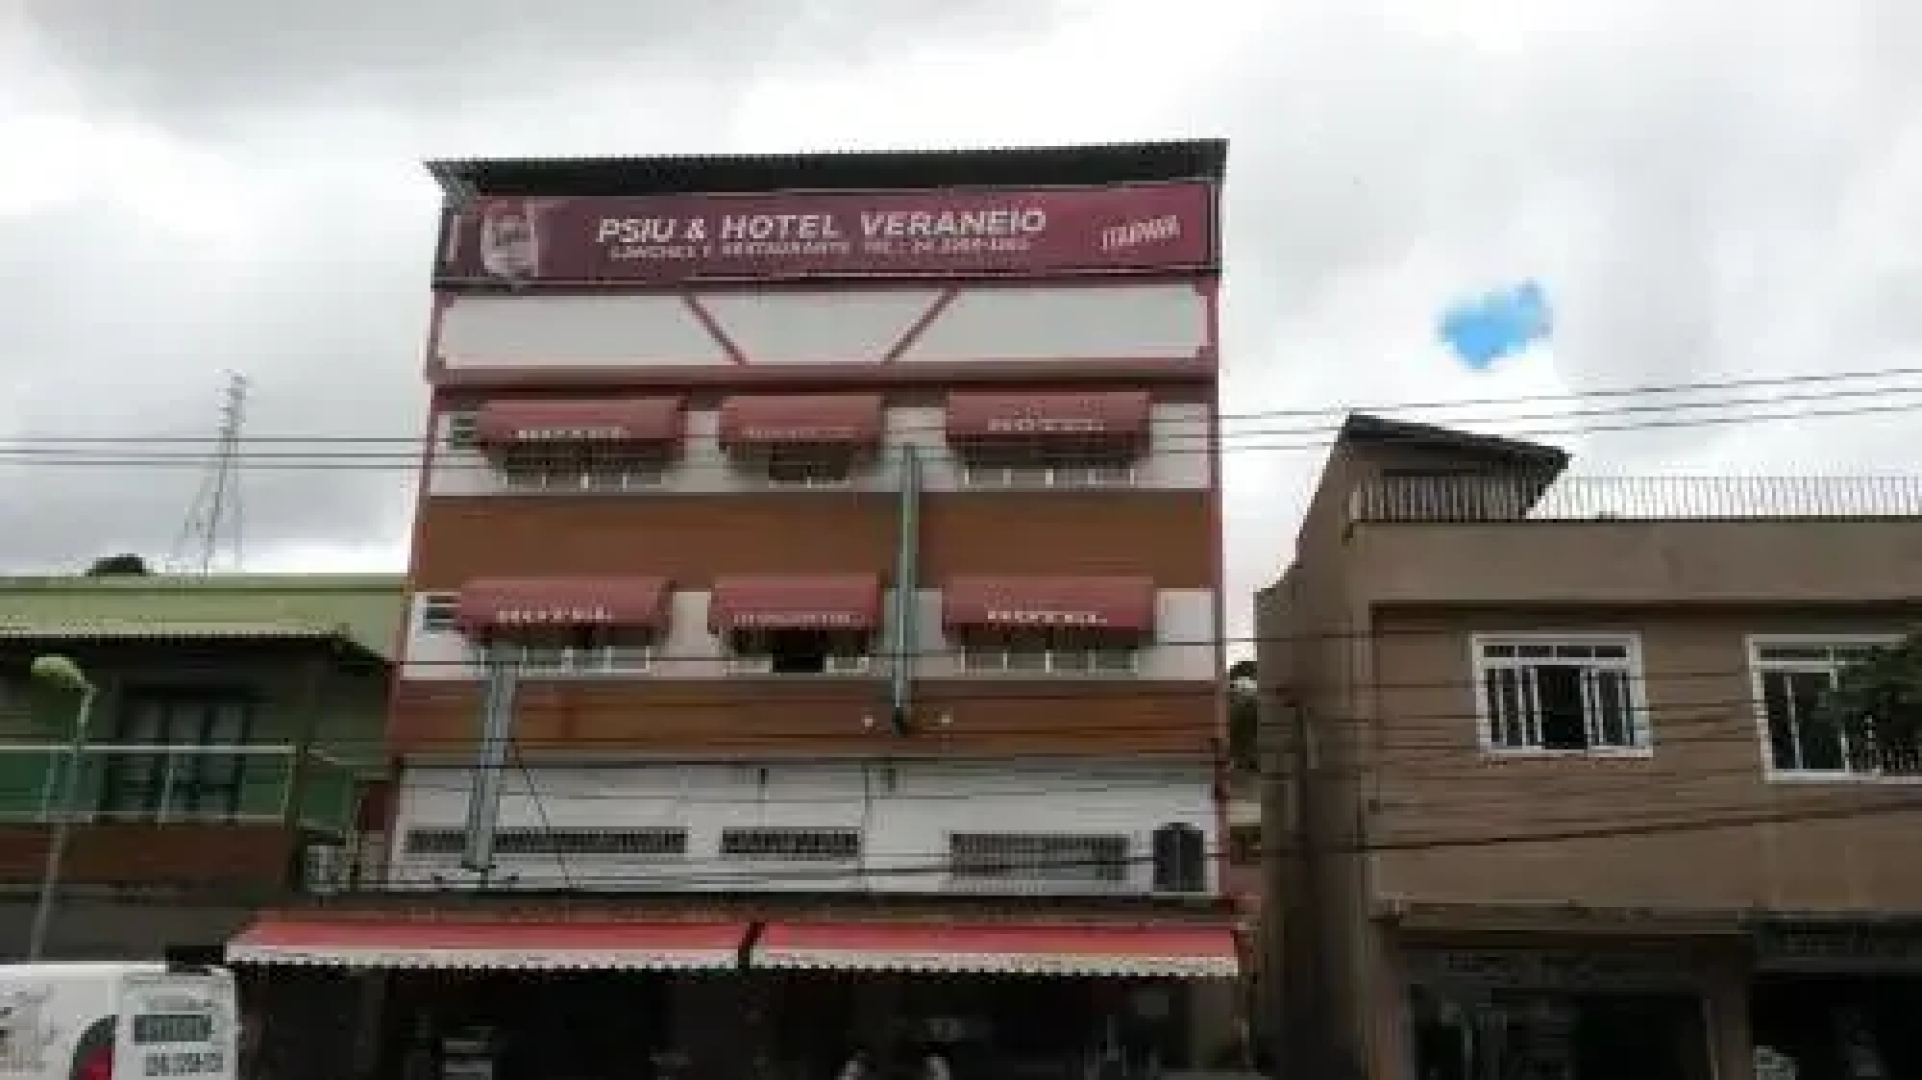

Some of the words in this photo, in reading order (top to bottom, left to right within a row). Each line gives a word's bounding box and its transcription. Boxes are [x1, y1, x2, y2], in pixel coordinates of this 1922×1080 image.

[596, 218, 676, 242] PSIU
[686, 218, 705, 240] &
[721, 214, 840, 239] HOTEL
[860, 209, 1046, 236] VERANEIO
